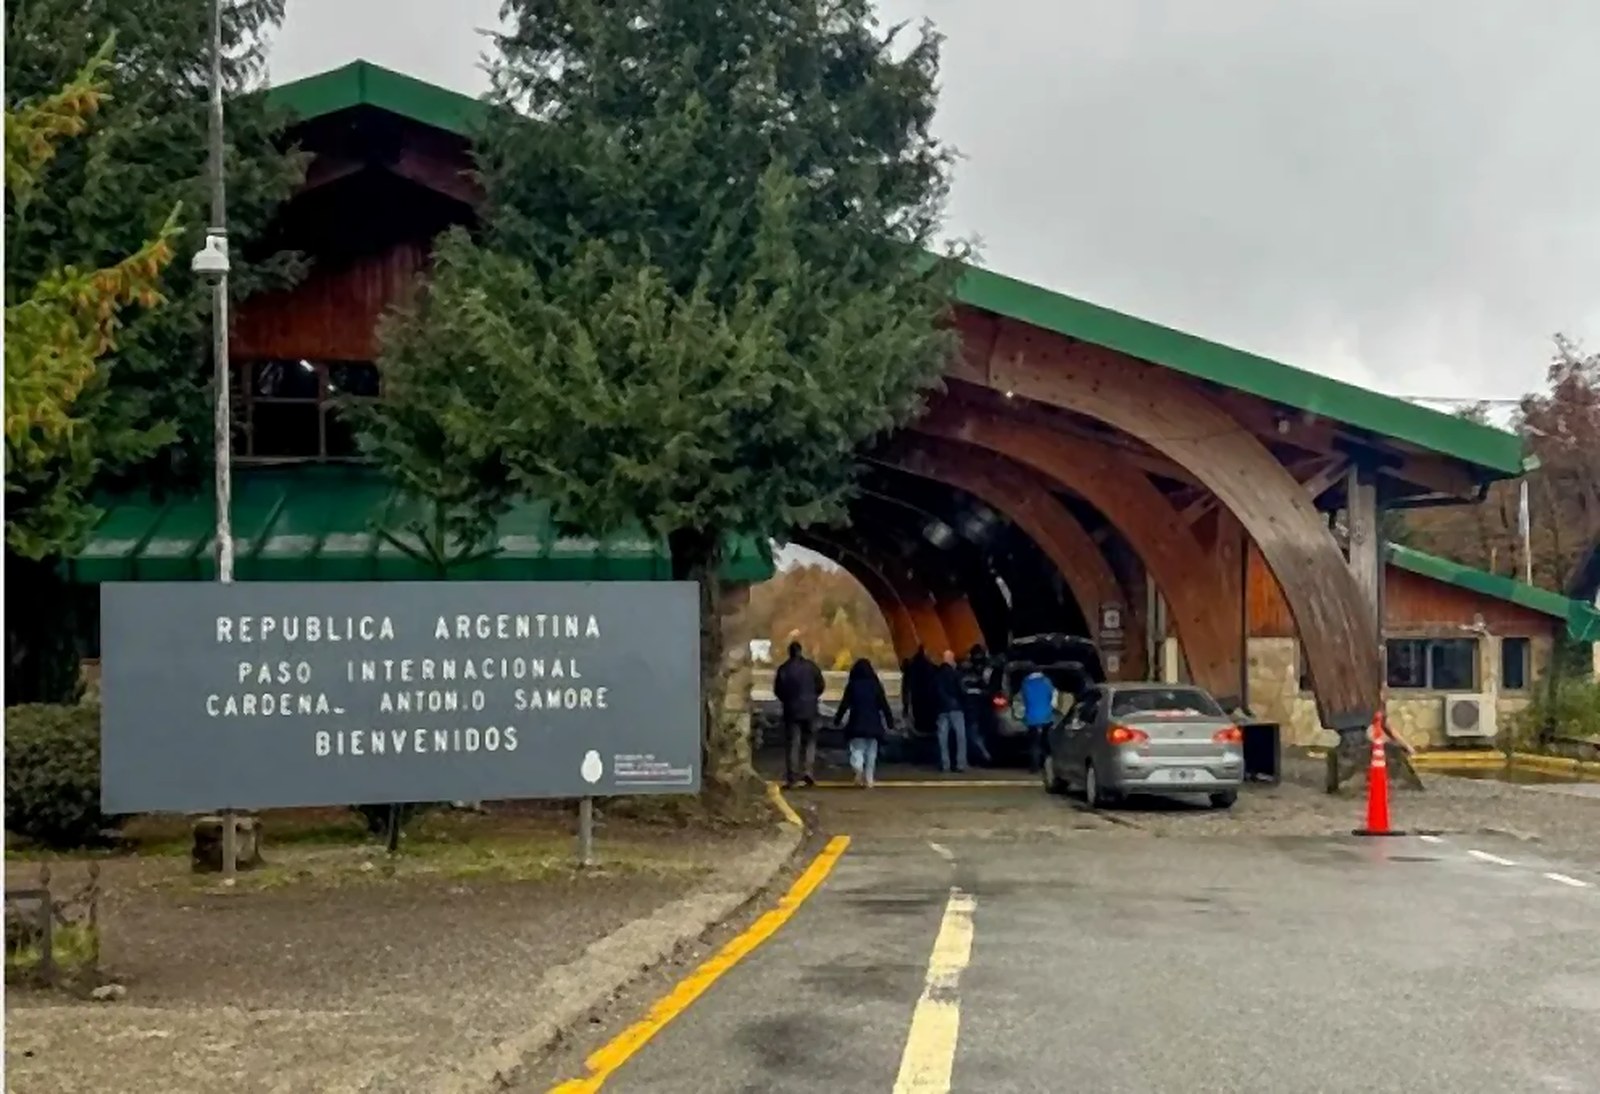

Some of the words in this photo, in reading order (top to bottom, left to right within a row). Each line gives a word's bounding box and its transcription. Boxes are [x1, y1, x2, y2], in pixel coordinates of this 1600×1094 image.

[216, 615, 395, 642] REPUBLICA
[434, 614, 601, 640] ARGENTINA
[238, 660, 312, 685] PASO
[347, 657, 582, 683] INTERNACIONAL
[379, 690, 485, 713] ANTONO
[514, 686, 609, 711] SAMORE
[315, 726, 518, 757] BIENVENIDOS
